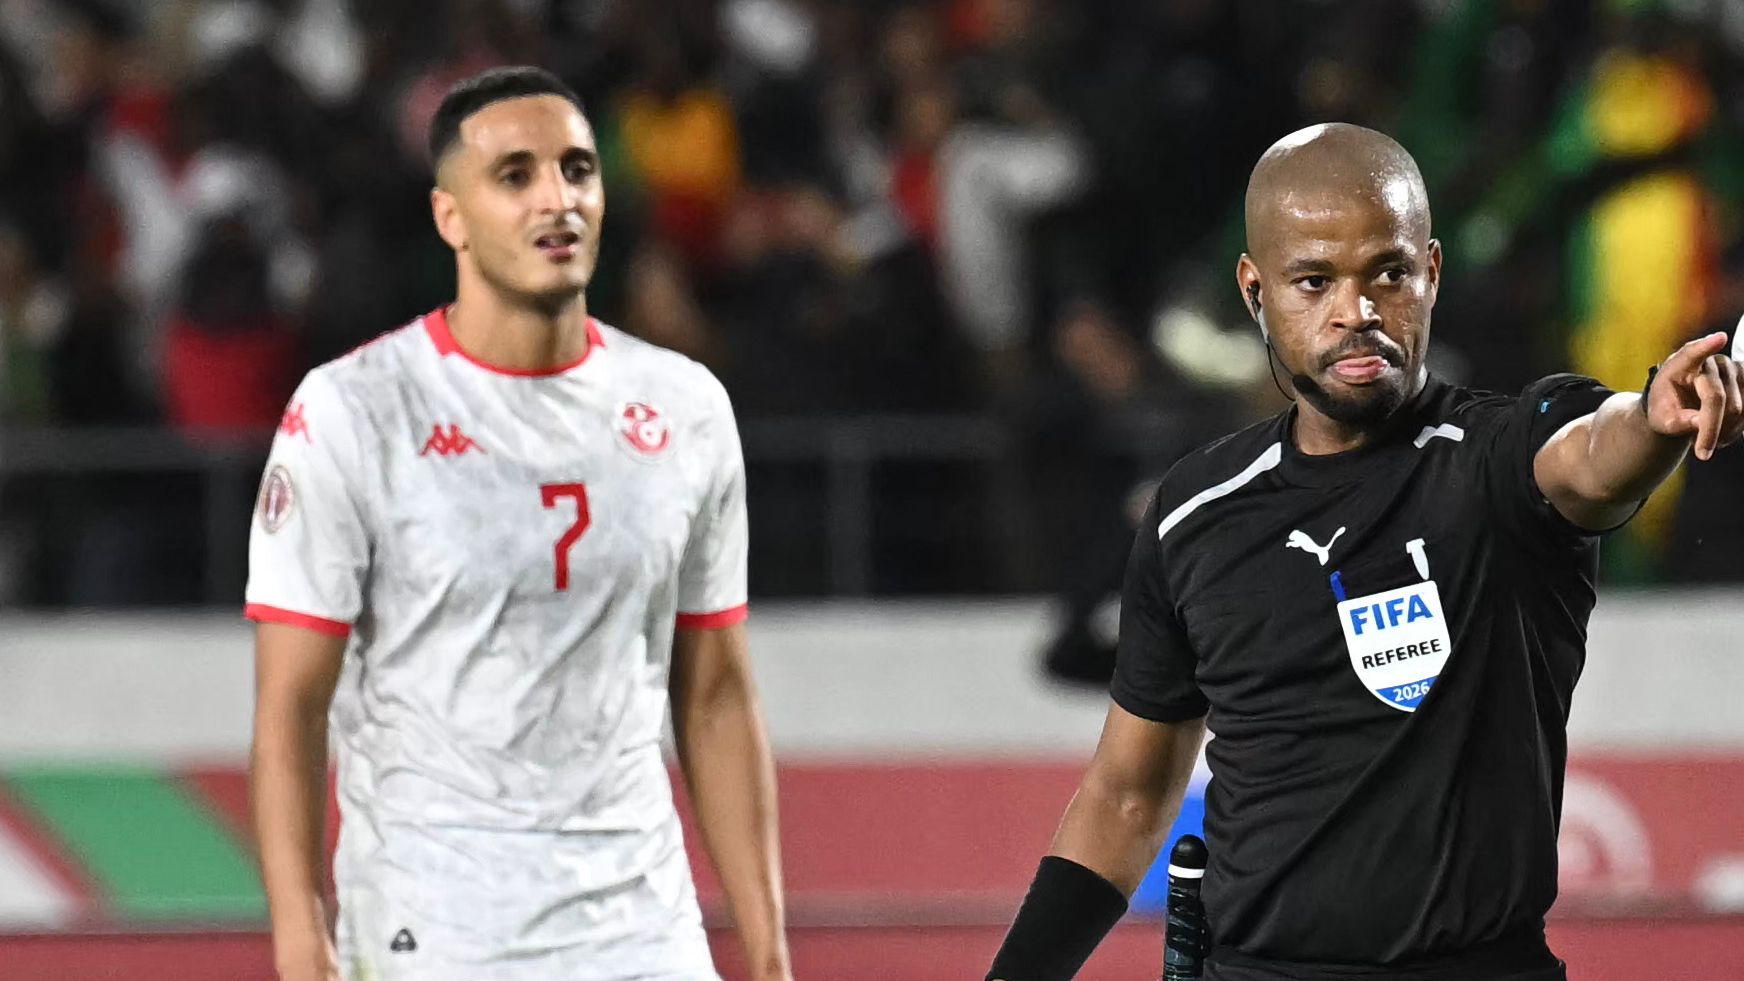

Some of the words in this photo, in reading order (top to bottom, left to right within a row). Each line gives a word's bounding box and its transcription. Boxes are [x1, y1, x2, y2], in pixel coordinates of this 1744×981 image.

[540, 482, 592, 591] 7
[1349, 594, 1433, 636] FIFA
[1361, 638, 1443, 670] REFEREE
[1393, 681, 1430, 702] 2026
